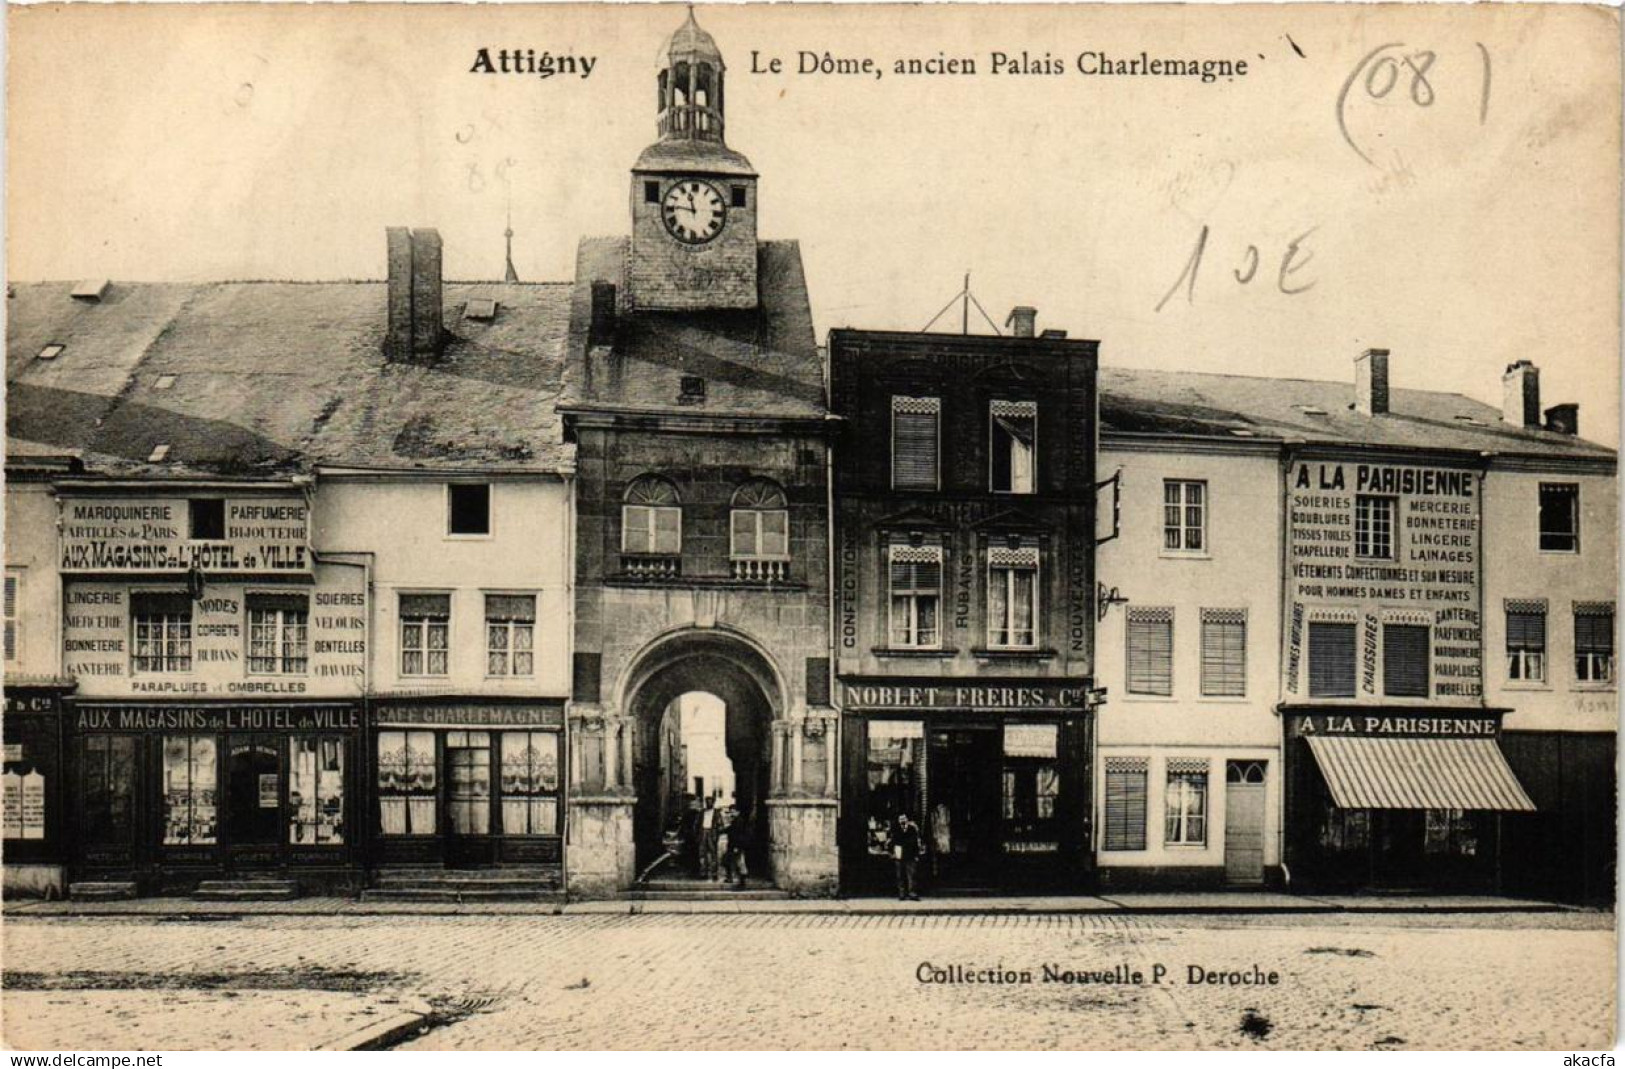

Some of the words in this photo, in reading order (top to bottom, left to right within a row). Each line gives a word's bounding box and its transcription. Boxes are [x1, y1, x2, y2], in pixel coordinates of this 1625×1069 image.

[1296, 464, 1310, 489] A
[1320, 465, 1345, 490] LA
[1357, 465, 1473, 497] PARISIENNE
[1294, 496, 1350, 509] SOIERIES
[1410, 501, 1471, 515] MERCERIE
[74, 506, 172, 523] MAROQUINERIE
[230, 506, 305, 520] PARFUMERIE
[1293, 512, 1350, 525] DOUBLURES
[1406, 516, 1477, 531] BONNETERIE
[69, 526, 127, 538] ARTICLES
[128, 526, 140, 538] de
[142, 524, 178, 540] PARIS
[229, 526, 307, 539] BIJOUTERIE
[1293, 528, 1322, 541] TISSUS
[1323, 529, 1352, 542] TOILES
[1411, 533, 1472, 547] LINGERIE
[62, 544, 89, 568] AUX
[91, 541, 167, 568] MAGASINS
[243, 552, 257, 569] de
[259, 545, 305, 569] VILLE
[1293, 544, 1350, 558] CHAPELLERIE
[1410, 549, 1473, 563] LAINAGES
[1408, 569, 1419, 582] ET
[1421, 570, 1437, 583] SUR
[1439, 570, 1475, 584] MESURE
[66, 592, 122, 605] LINGERIE
[955, 554, 974, 629] RUBANS
[1298, 585, 1324, 598] POUR
[1326, 585, 1367, 599] HOMMES
[1369, 587, 1406, 600] DAMES
[1410, 588, 1422, 600] ET
[1426, 589, 1471, 602] ENFANTS
[197, 598, 239, 615] MODES
[315, 593, 365, 606] SOIERIES
[315, 616, 365, 629] VELOURS
[1435, 607, 1480, 625] GANTERIE
[197, 624, 239, 637] CORSETS
[65, 639, 125, 652] BONNETERIE
[314, 640, 365, 653] DENTELLES
[1362, 614, 1378, 695] CHAUSSURES
[67, 663, 124, 676] GANTERIE
[132, 682, 208, 693] PARAPLUIES
[227, 682, 306, 693] OMBRELLES
[847, 686, 939, 706] NOBLET
[79, 708, 112, 729] AUX
[120, 708, 207, 729] MAGASINS
[208, 715, 225, 729] de
[299, 715, 315, 729] de
[314, 708, 359, 729] VILLE
[422, 707, 554, 724] CHARLEMAGNE
[1301, 716, 1315, 732] A
[1326, 716, 1356, 732] LA
[1364, 716, 1495, 734] PARISIENNE
